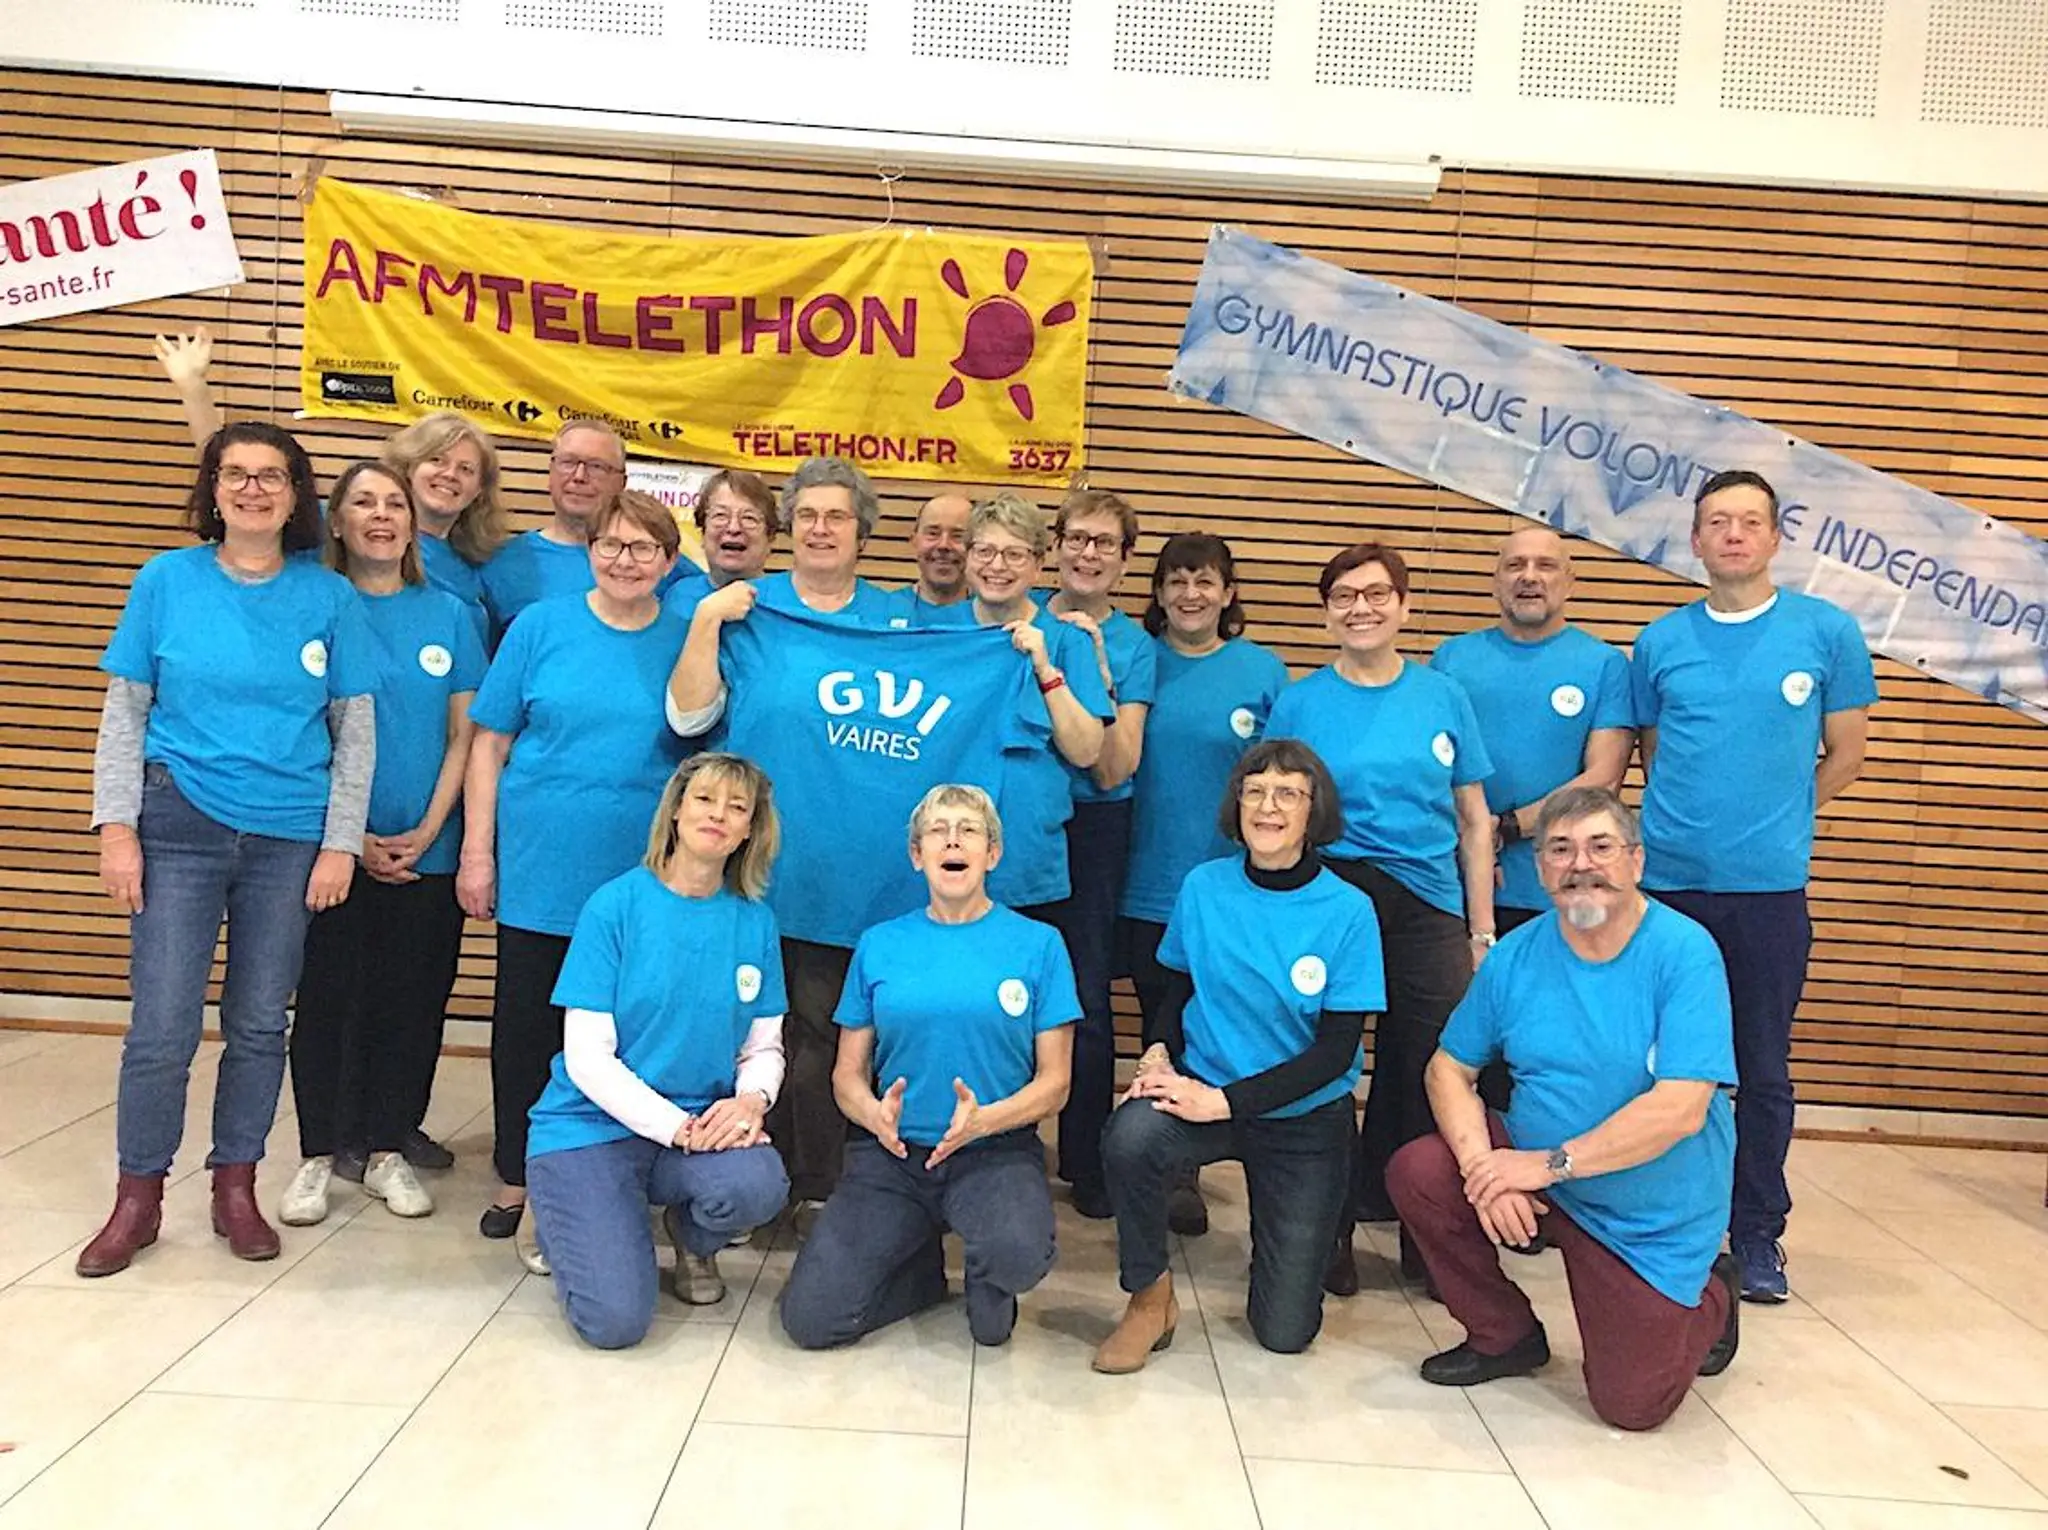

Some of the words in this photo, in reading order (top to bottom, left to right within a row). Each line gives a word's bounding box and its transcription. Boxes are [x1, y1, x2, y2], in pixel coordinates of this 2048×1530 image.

[179, 169, 207, 230] !
[412, 389, 494, 412] Carrefour
[732, 431, 957, 464] TELETHON.FR
[1008, 447, 1070, 472] 3637
[1214, 295, 1528, 434] GYMNASTIQUE
[1540, 405, 1810, 542] VOLONTE
[1813, 515, 2048, 646] INDEPENDA
[827, 721, 921, 761] VAIRES
